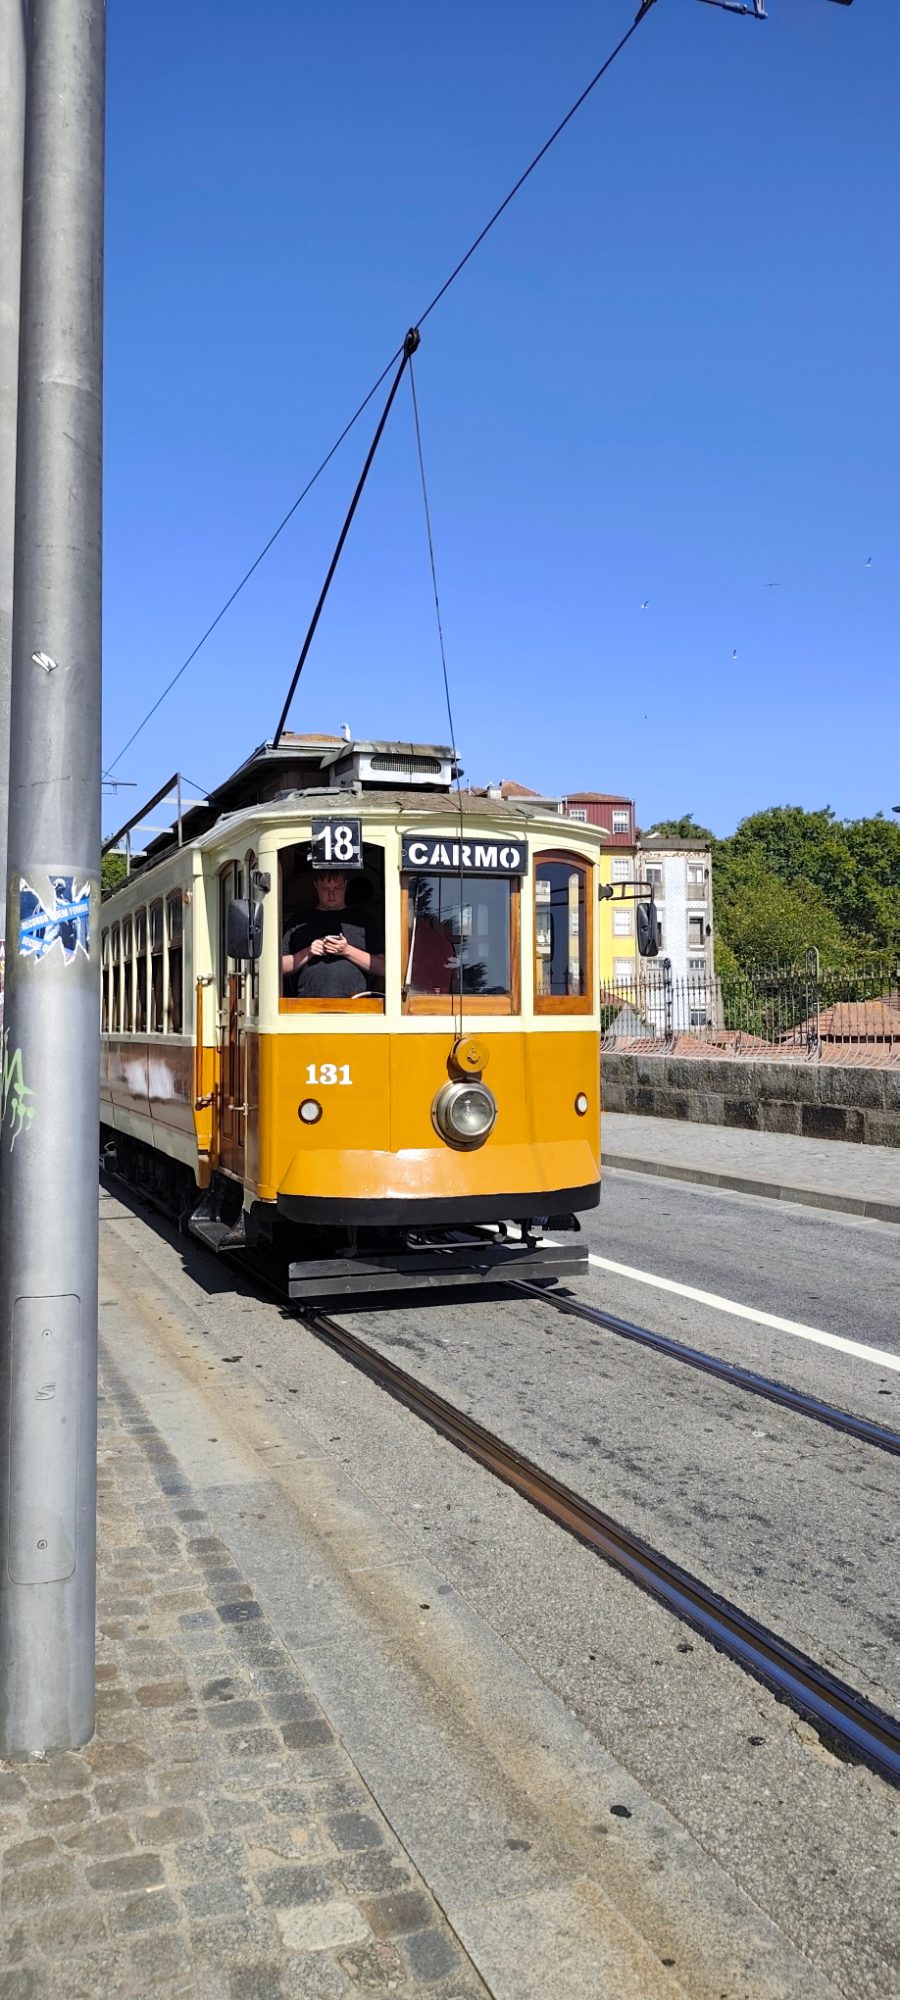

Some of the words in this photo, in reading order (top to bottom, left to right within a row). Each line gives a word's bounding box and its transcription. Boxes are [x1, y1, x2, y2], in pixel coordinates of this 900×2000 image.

[318, 826, 353, 861] 18
[408, 842, 521, 868] CARMO
[305, 1064, 353, 1085] 131
